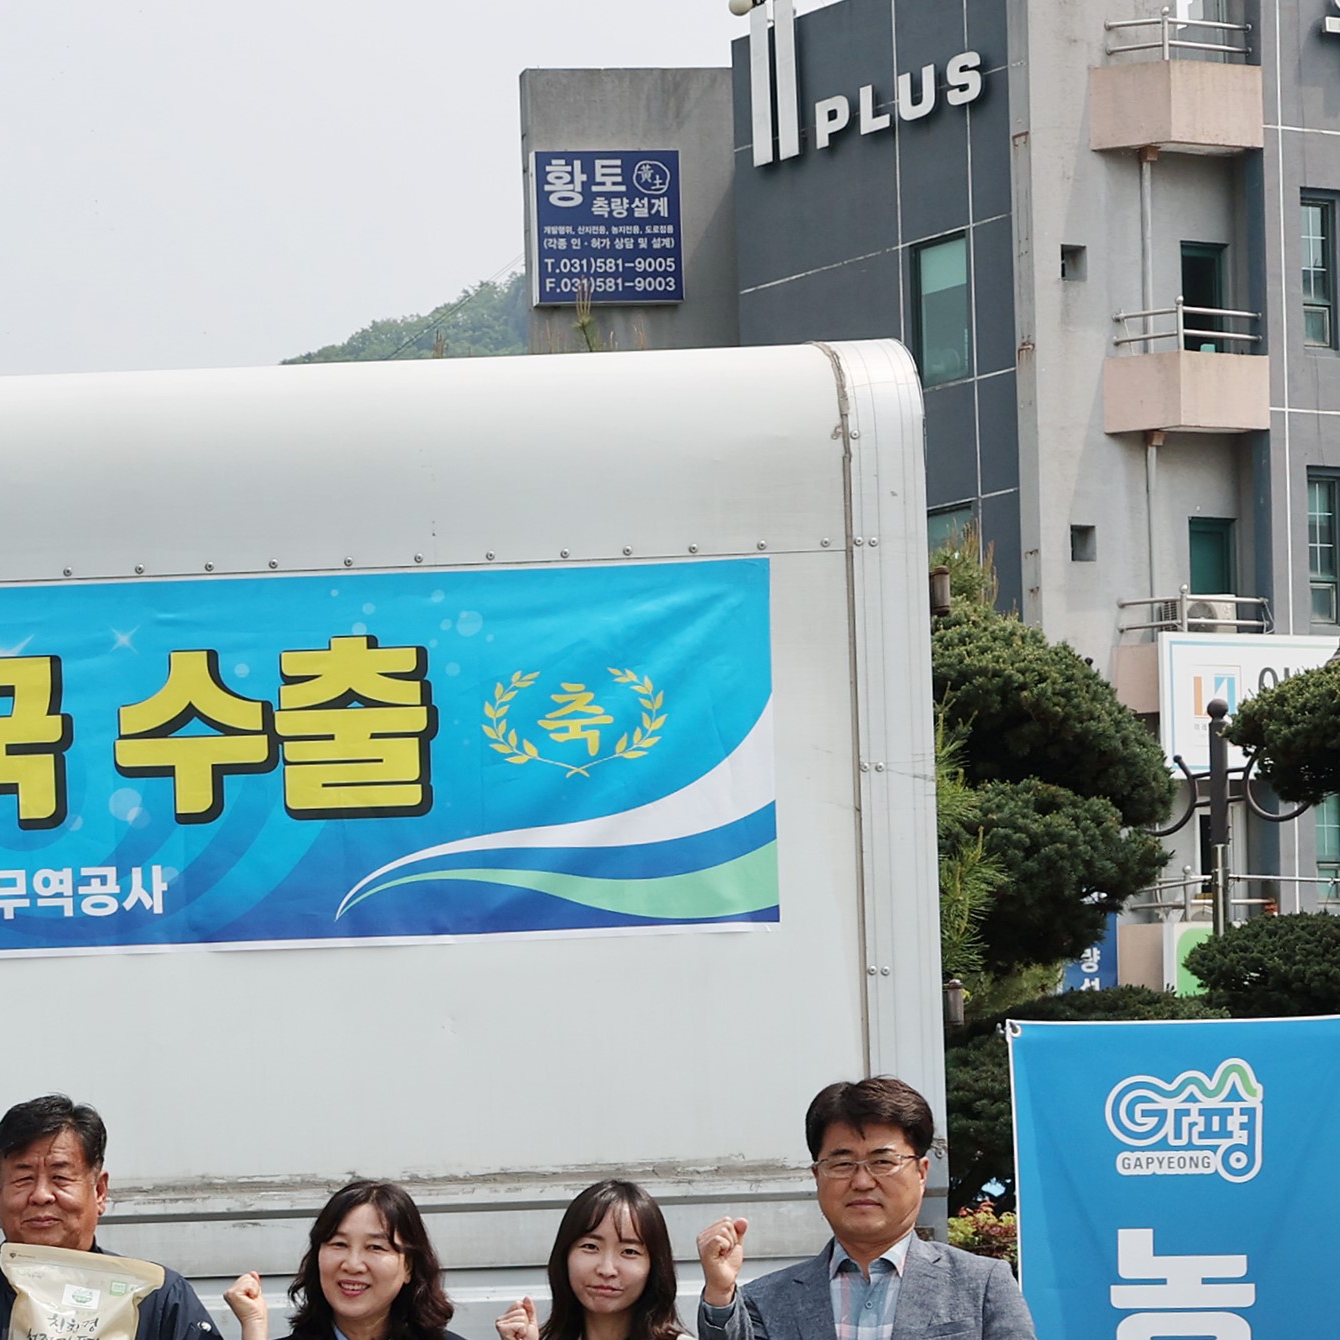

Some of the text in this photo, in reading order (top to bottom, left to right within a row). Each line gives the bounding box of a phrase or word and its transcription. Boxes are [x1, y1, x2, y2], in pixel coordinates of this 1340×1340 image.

[815, 51, 982, 149] PLUS
[544, 159, 626, 207] 황토
[591, 197, 668, 218] 측량설계
[614, 238, 634, 249] 상담
[638, 238, 648, 249] 및
[544, 257, 676, 273] T.031)581-9005
[114, 633, 439, 825] 수출
[536, 681, 615, 756] 축
[1121, 1155, 1211, 1170] GAPYEONG
